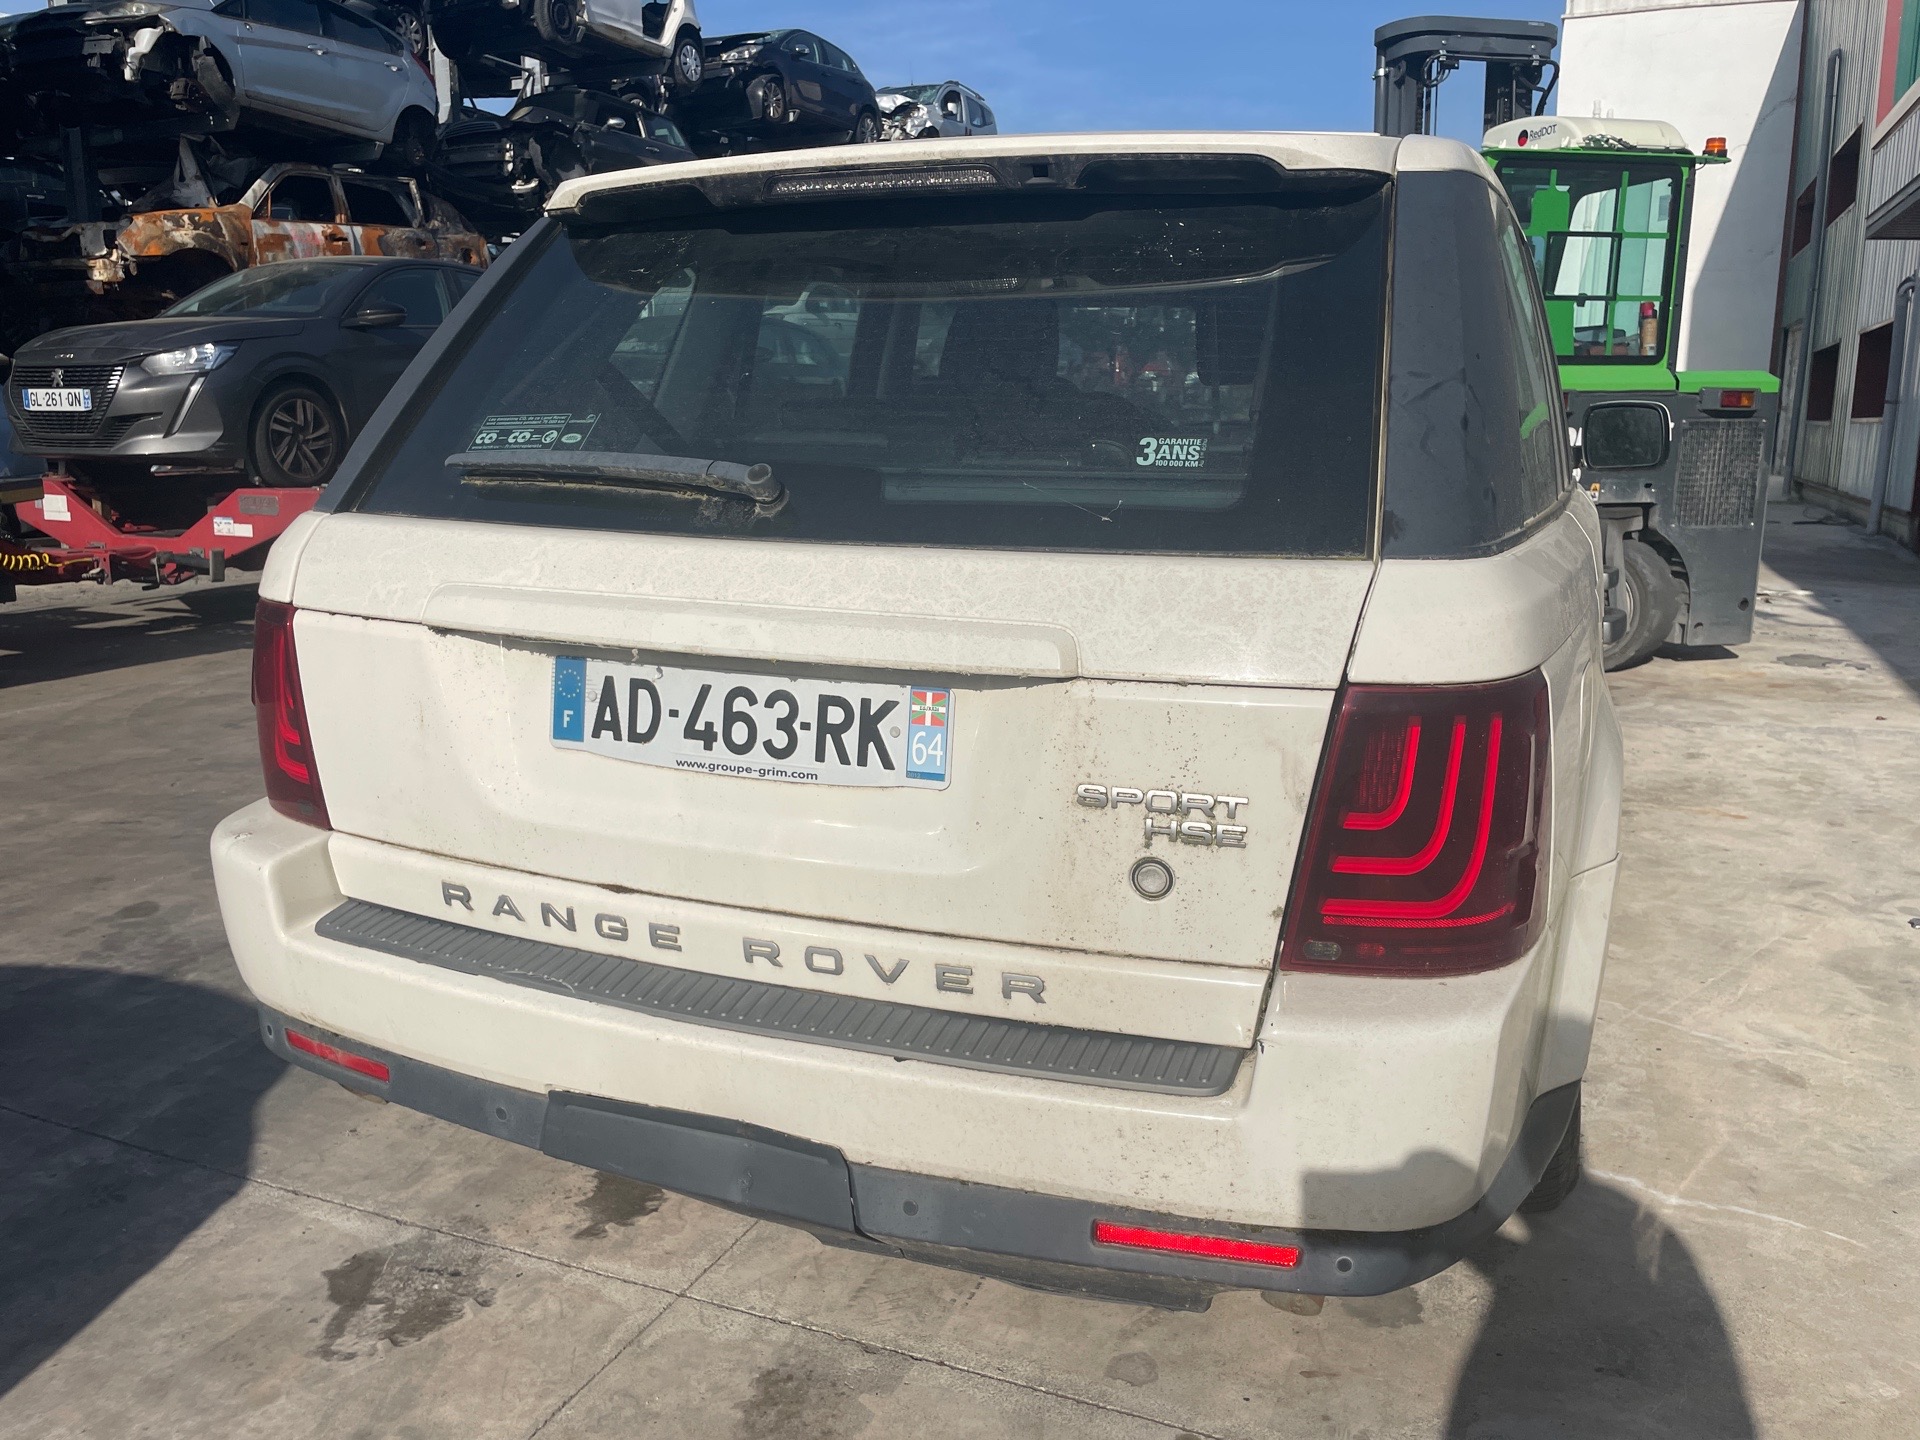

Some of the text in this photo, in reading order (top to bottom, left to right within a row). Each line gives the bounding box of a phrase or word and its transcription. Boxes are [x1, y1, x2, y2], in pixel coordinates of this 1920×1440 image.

[1529, 124, 1557, 140] RedDOT
[1136, 437, 1158, 466] 3
[1155, 444, 1201, 461] ANS
[1158, 437, 1202, 446] GARANTIE
[1155, 459, 1168, 467] 100
[1184, 460, 1199, 468] KM
[562, 709, 574, 728] F
[591, 674, 900, 771] AD-463-RK
[912, 730, 944, 767] 64
[675, 758, 818, 781] www.groupe-grim.com
[1076, 783, 1250, 820] SPORT
[1144, 817, 1248, 849] HSE
[440, 879, 682, 953] RANGE
[743, 935, 1047, 1005] ROVER
